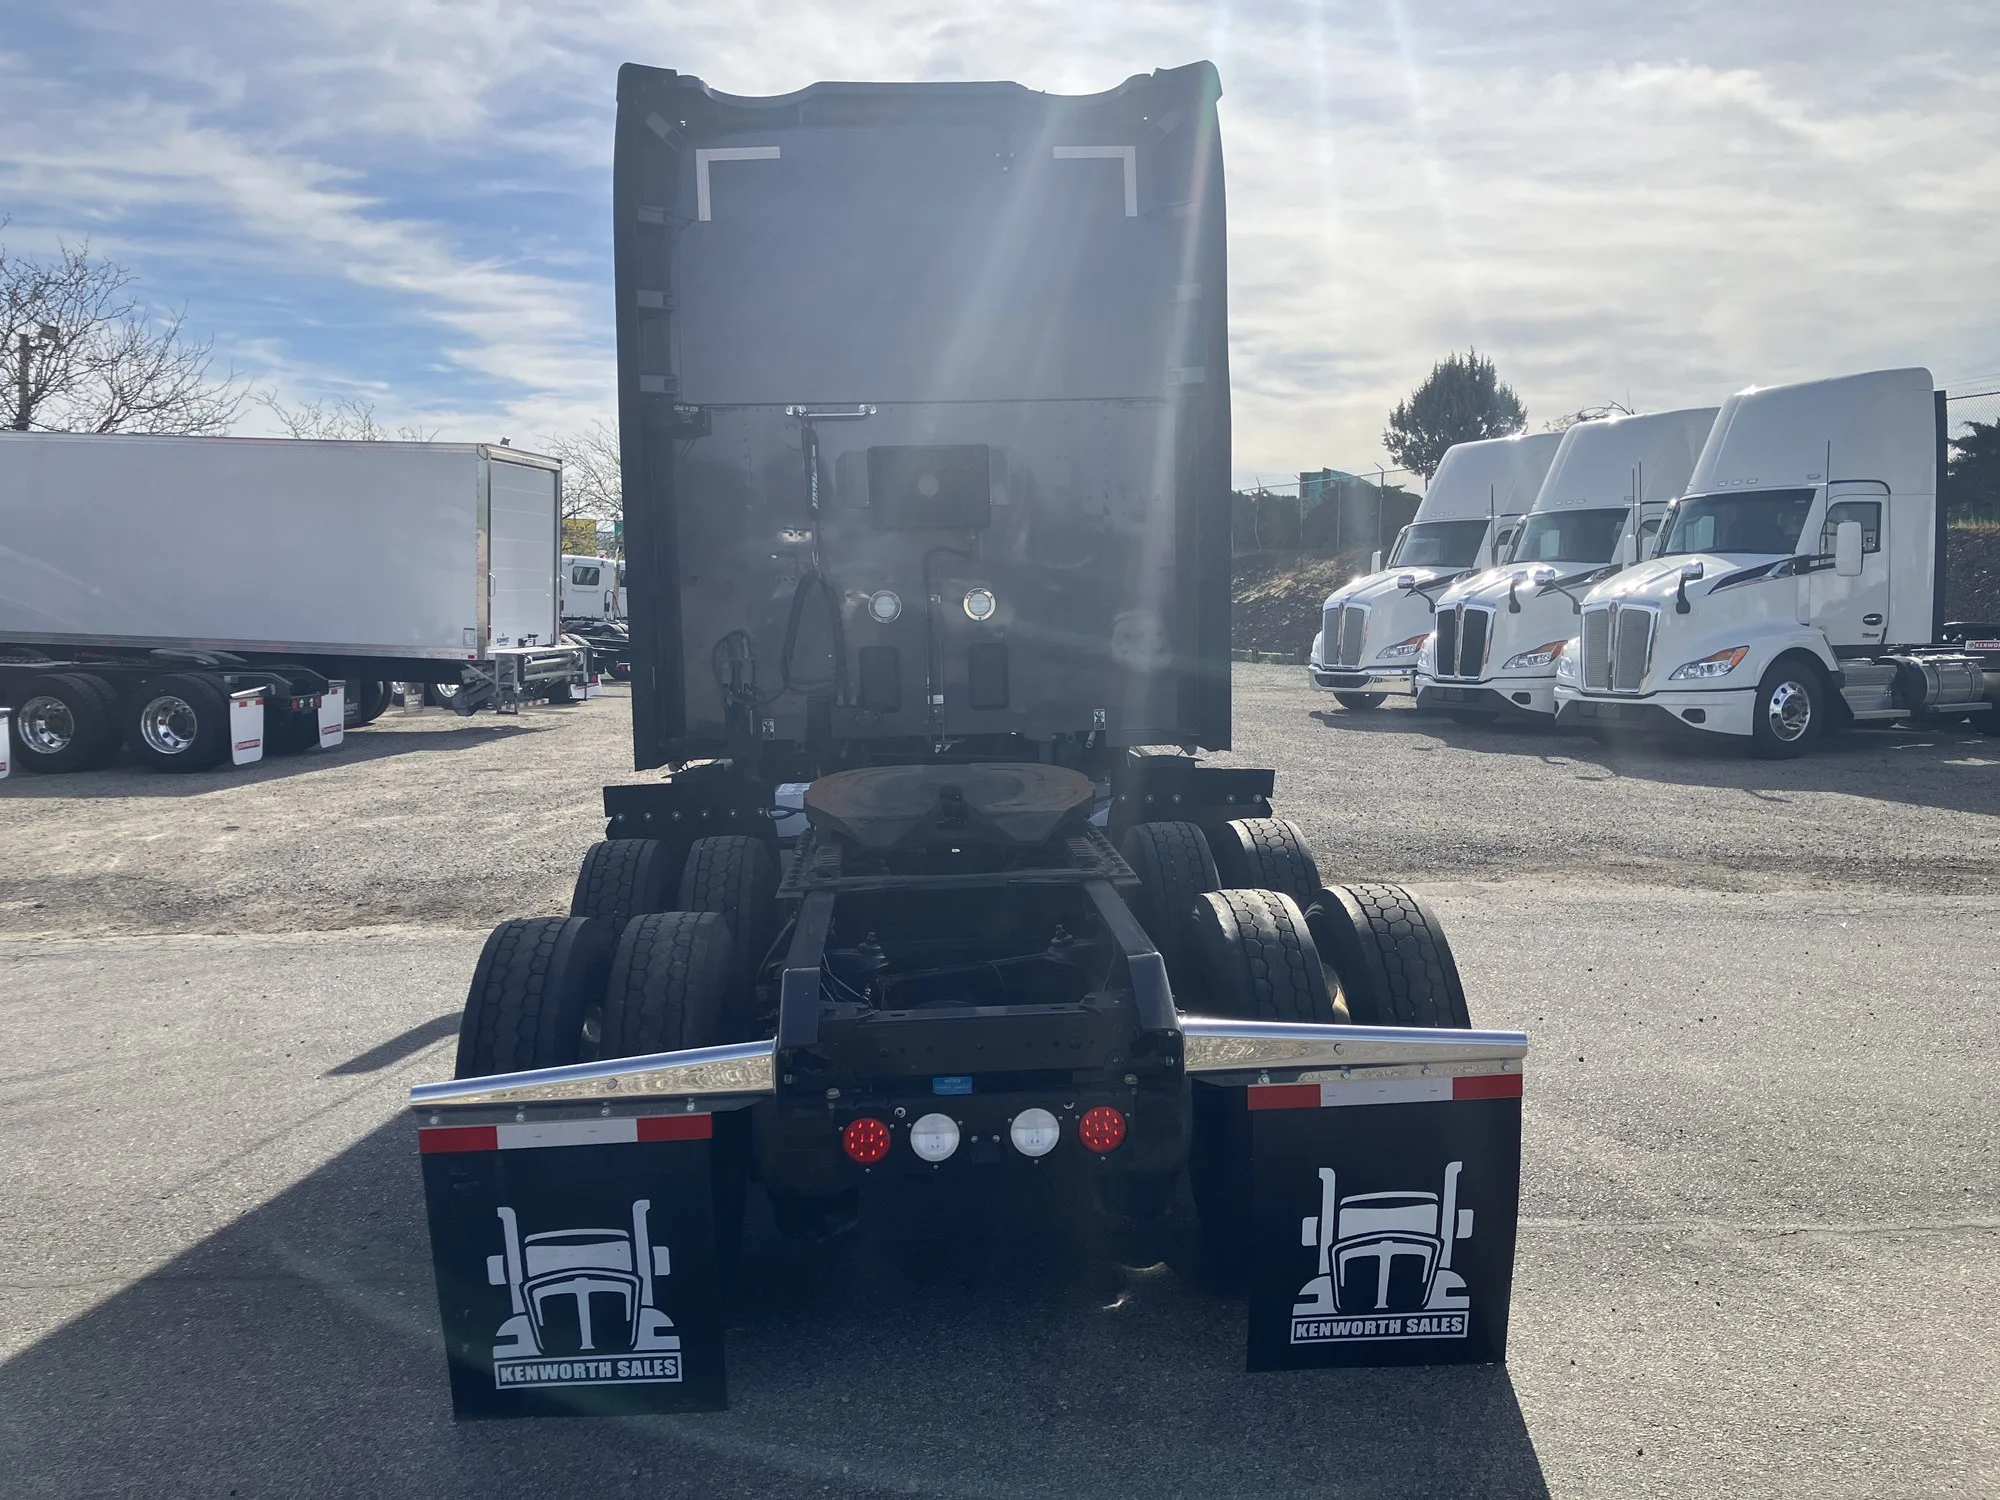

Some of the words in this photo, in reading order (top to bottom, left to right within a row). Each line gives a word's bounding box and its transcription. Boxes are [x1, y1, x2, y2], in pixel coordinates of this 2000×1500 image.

[1296, 1320, 1400, 1338] KENWORTH
[1406, 1318, 1462, 1333] SALES
[500, 1361, 611, 1382] KENWORTH
[617, 1359, 676, 1377] SALES
